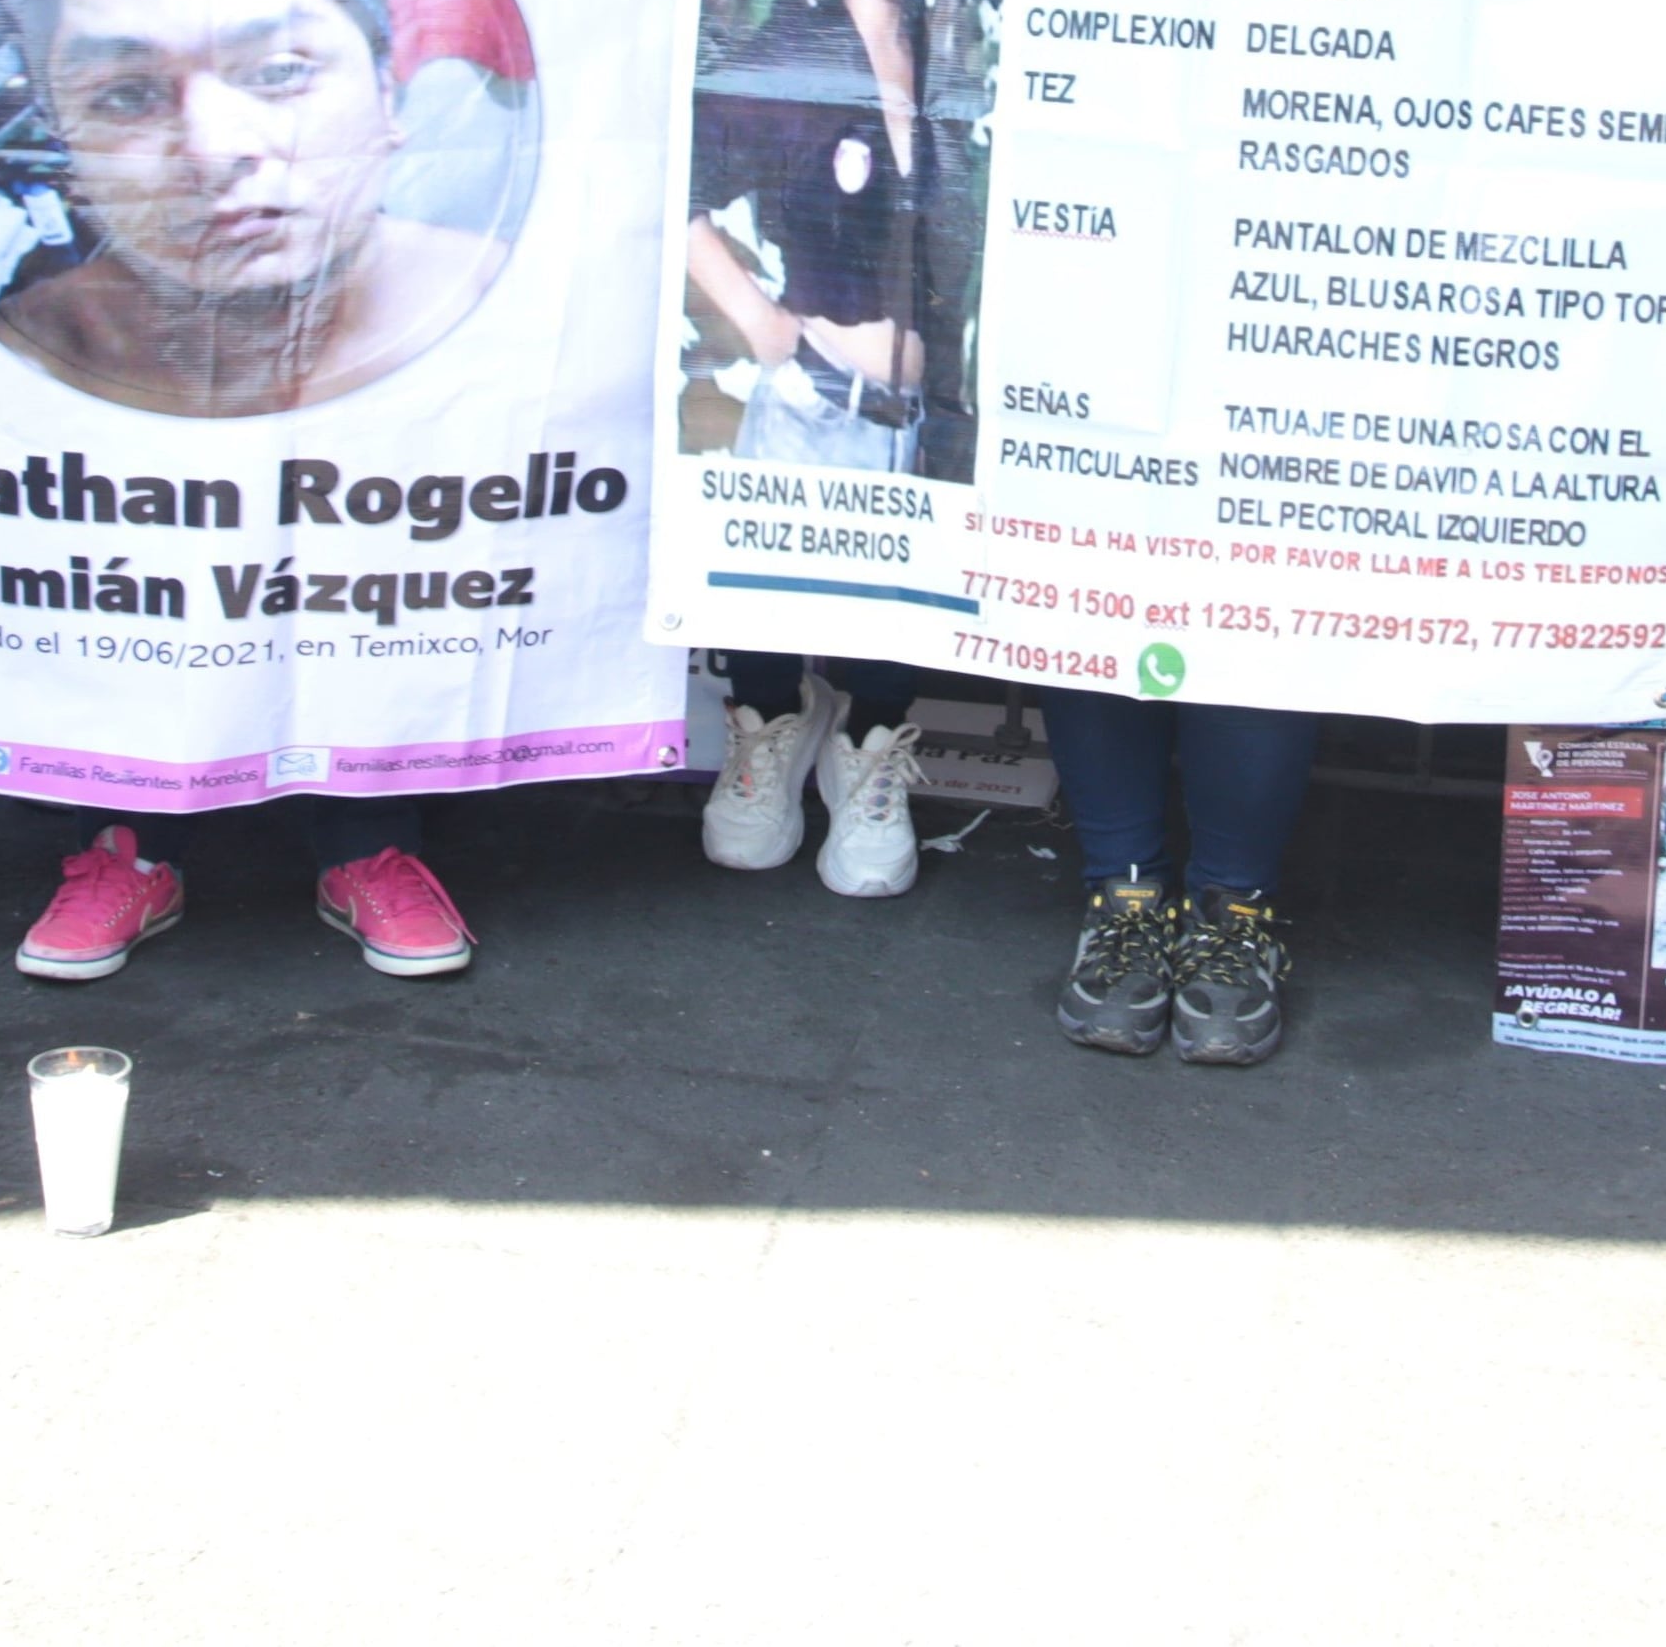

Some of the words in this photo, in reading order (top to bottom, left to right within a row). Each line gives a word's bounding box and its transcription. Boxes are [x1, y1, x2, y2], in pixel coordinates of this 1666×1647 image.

[1025, 6, 1216, 51] COMPLEXION
[1246, 22, 1397, 62] DELGADA
[1024, 70, 1077, 105] TEZ
[1242, 88, 1383, 131] MORENA,
[1393, 95, 1474, 132] OJOS
[1484, 102, 1587, 139] CAFES
[1239, 141, 1411, 179] RASGADOS
[1233, 218, 1397, 259] PANTALON
[1405, 228, 1447, 262] DE
[1455, 231, 1628, 272] MEZCLILLA
[1230, 271, 1319, 312] AZUL,
[1326, 277, 1434, 314] BLUSA
[1437, 283, 1527, 318] ROSA
[1535, 288, 1605, 322] TIPO
[1225, 322, 1422, 364] HUARACHES
[1431, 334, 1561, 371] NEGROS
[1003, 382, 1091, 420] SEÑAS
[1224, 404, 1346, 441] TATUAJE
[1353, 413, 1390, 444] DE
[1397, 417, 1462, 449] UNA
[1463, 419, 1543, 452] ROSA
[1548, 426, 1610, 455] CON
[1619, 429, 1651, 457] EL
[1000, 438, 1200, 487] PARTICULARES
[1219, 453, 1341, 486] NOMBRE
[1349, 460, 1387, 489] DE
[1395, 464, 1477, 495] DAVID
[1483, 470, 1503, 497] A
[1511, 471, 1548, 499] LA
[1552, 474, 1661, 503] ALTURA
[278, 451, 628, 542] Rogelio
[701, 468, 808, 508] SUSANA
[819, 479, 934, 523] VANESSA
[724, 519, 792, 552] CRUZ
[800, 526, 911, 564] BARRIOS
[964, 512, 984, 532] SI
[991, 515, 1062, 543] USTED
[1071, 526, 1098, 549] LA
[1107, 531, 1137, 553] HA
[1145, 536, 1221, 564] VISTO,
[1230, 541, 1277, 565] POR
[1286, 545, 1361, 572] FAVOR
[1371, 553, 1449, 578] LLAME
[1455, 559, 1472, 579] A
[1481, 559, 1525, 582] LOS
[1217, 497, 1273, 528] DEL
[1279, 501, 1429, 539] PECTORAL
[1437, 513, 1587, 548] IZQUIERDO
[212, 556, 535, 626] Vázquez
[961, 570, 1059, 609] 777329
[1068, 588, 1135, 620] 1500
[1145, 599, 1191, 627] ext
[1201, 601, 1279, 639] 1235,
[1291, 607, 1479, 651] 7773291572,
[1491, 620, 1666, 649] 7773822592
[35, 631, 60, 655] el
[78, 634, 285, 669] 19/06/2021,
[296, 639, 334, 658] en
[350, 633, 484, 659] Temixco,
[497, 624, 554, 649] Mor
[953, 631, 1119, 681] 7771091248
[20, 757, 86, 780] Familias
[91, 764, 182, 790] Resilientes
[190, 767, 259, 790] Morelos
